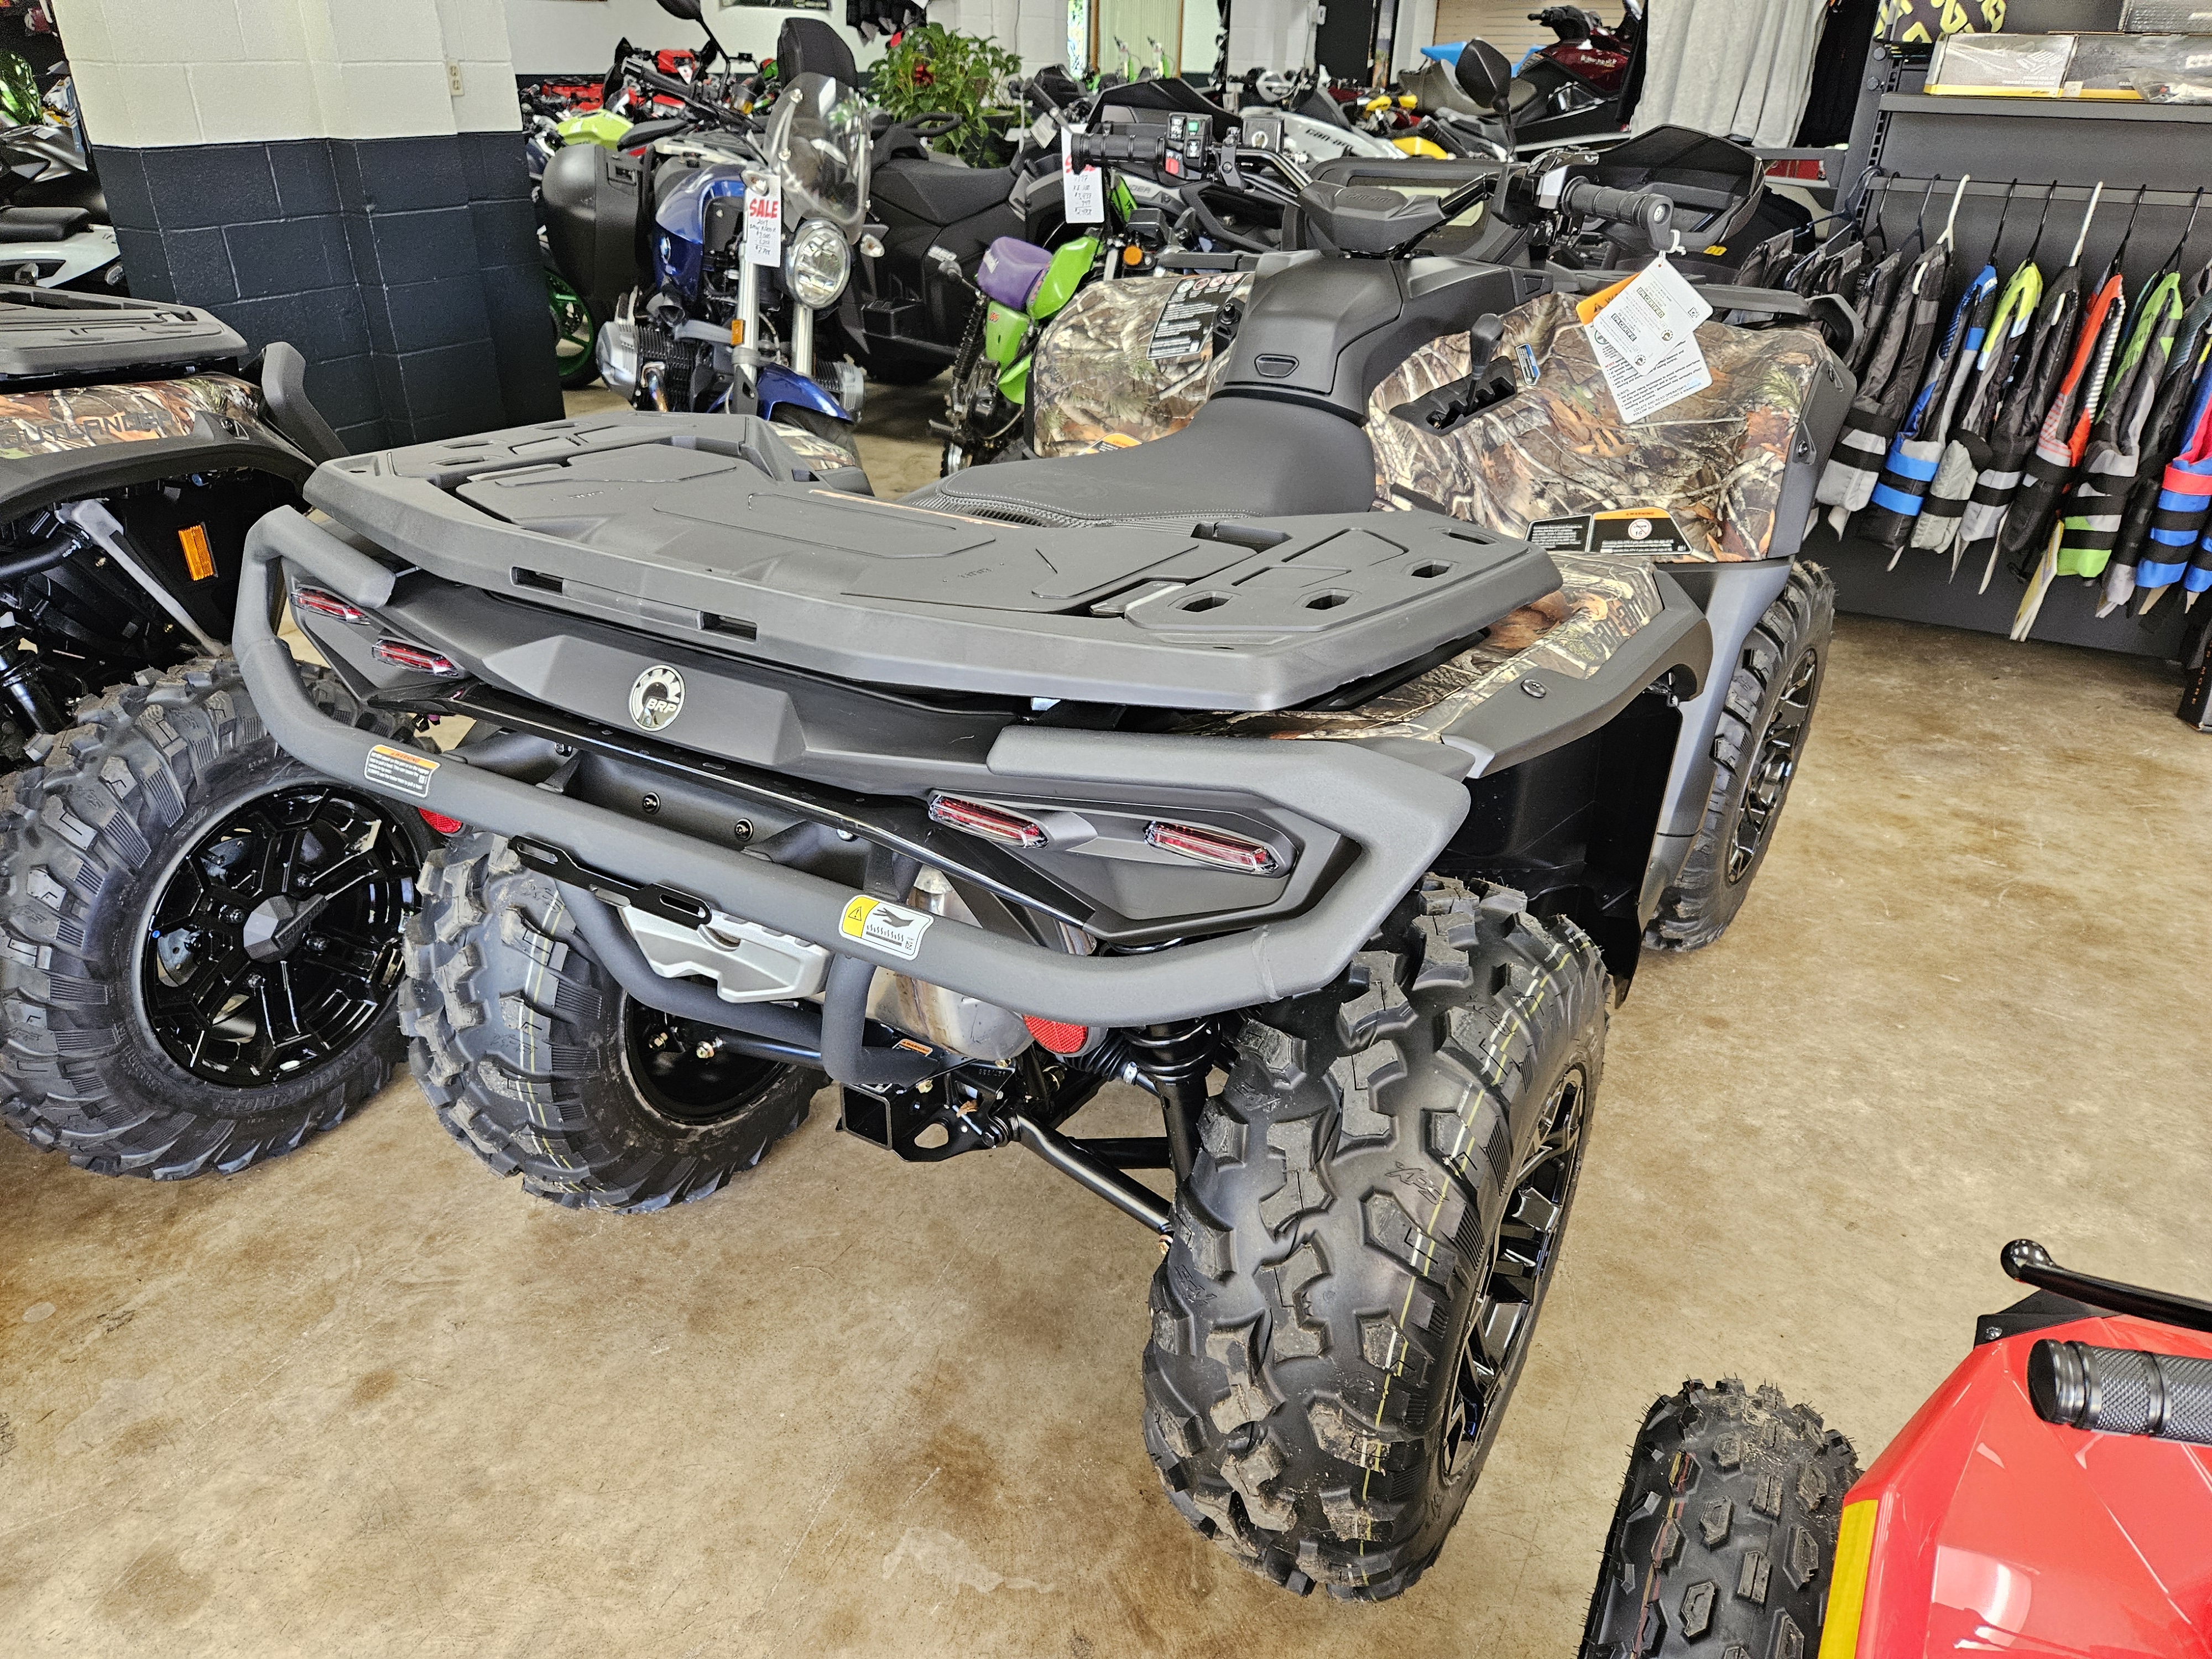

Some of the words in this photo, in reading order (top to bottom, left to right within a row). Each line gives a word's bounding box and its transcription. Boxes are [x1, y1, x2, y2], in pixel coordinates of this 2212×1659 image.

[749, 198, 779, 219] SALE
[1636, 287, 1647, 298] EPA
[1642, 295, 1665, 317] CERTIFIED
[1611, 314, 1621, 324] EPA
[1632, 407, 1647, 417] FOLLOW
[1633, 403, 1647, 412] LOCATE
[0, 413, 174, 448] OUTLANDER
[1582, 596, 1647, 659] can-am
[646, 698, 677, 714] BRP
[906, 1042, 930, 1053] WARNING
[1385, 1161, 1450, 1206] XPS
